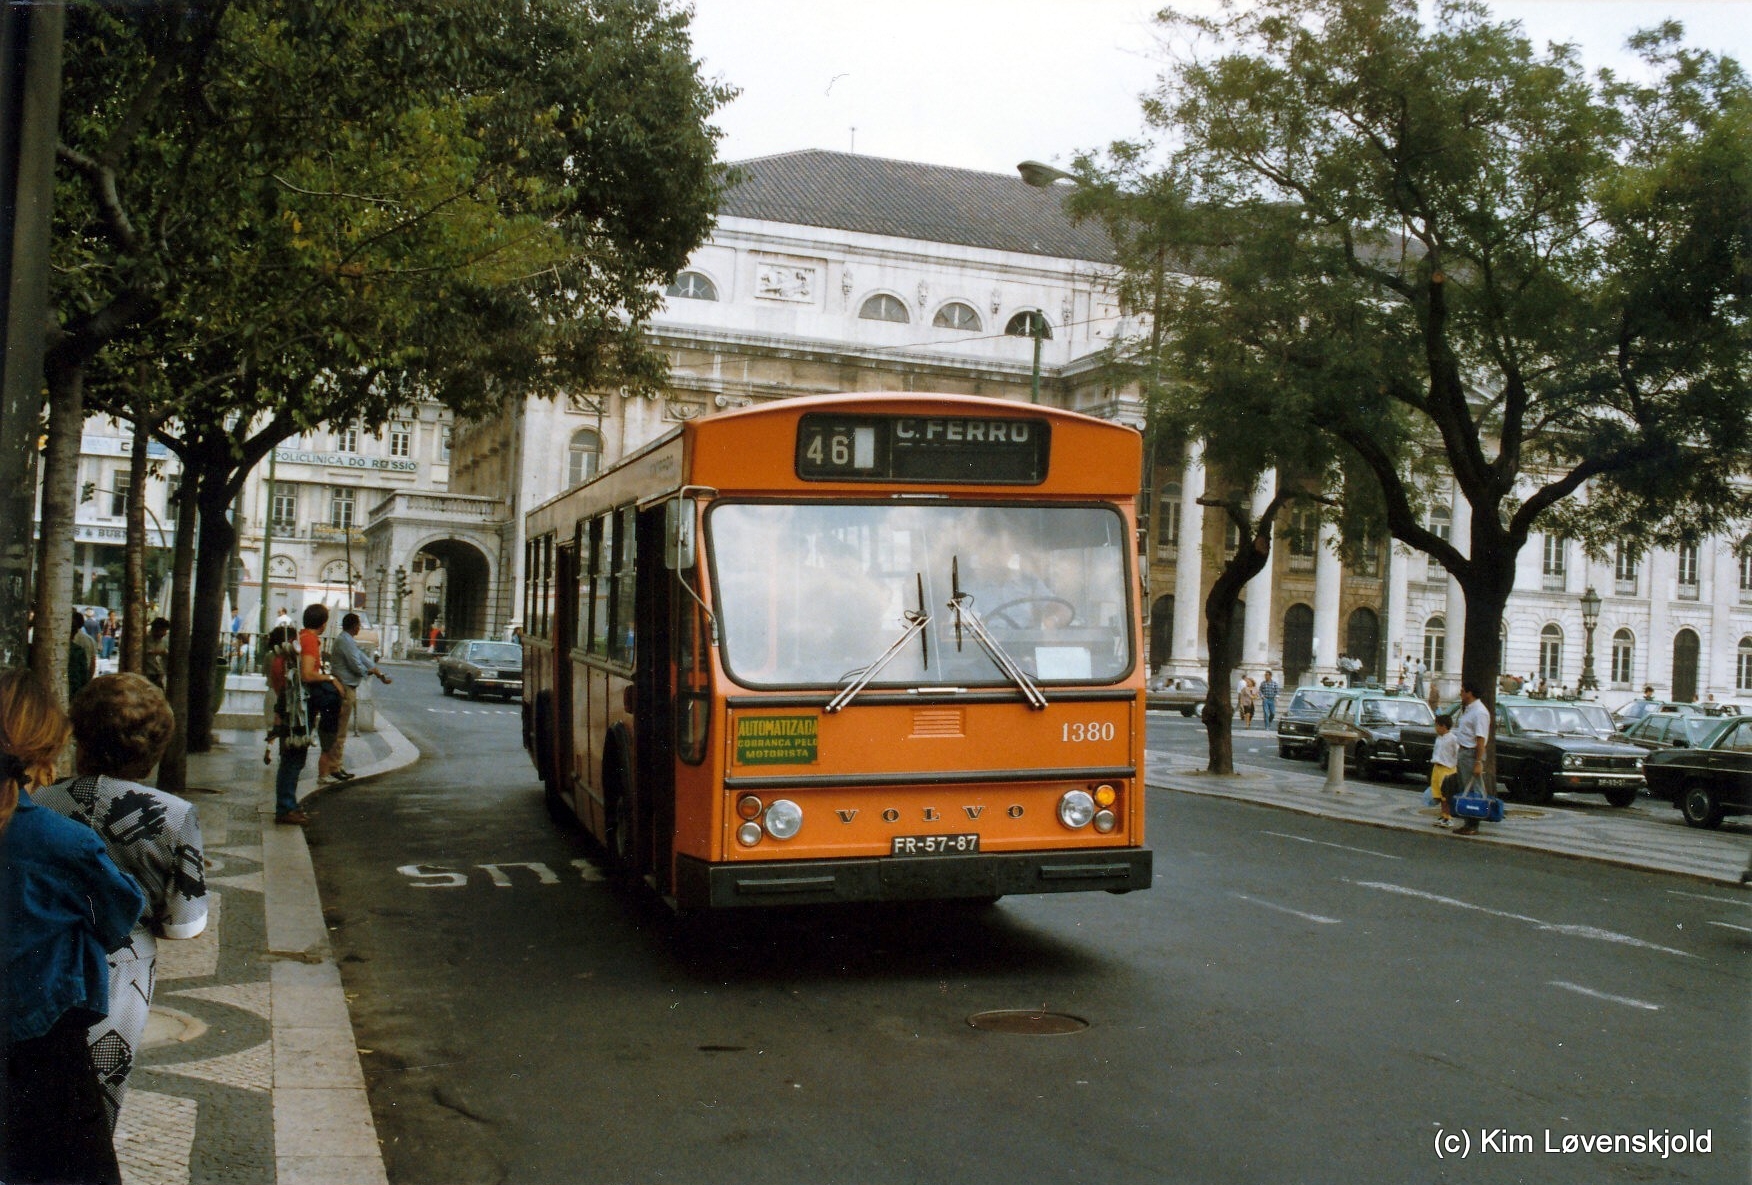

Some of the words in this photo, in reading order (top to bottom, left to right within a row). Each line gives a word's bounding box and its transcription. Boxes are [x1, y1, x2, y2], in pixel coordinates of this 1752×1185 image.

[275, 451, 344, 467] POLICLINICA
[348, 457, 365, 467] DO
[806, 434, 849, 465] 46
[1062, 722, 1115, 742] 1380
[745, 748, 809, 758] MOTORISTA
[835, 804, 1025, 824] VOLVO
[893, 835, 978, 853] FR-57-87
